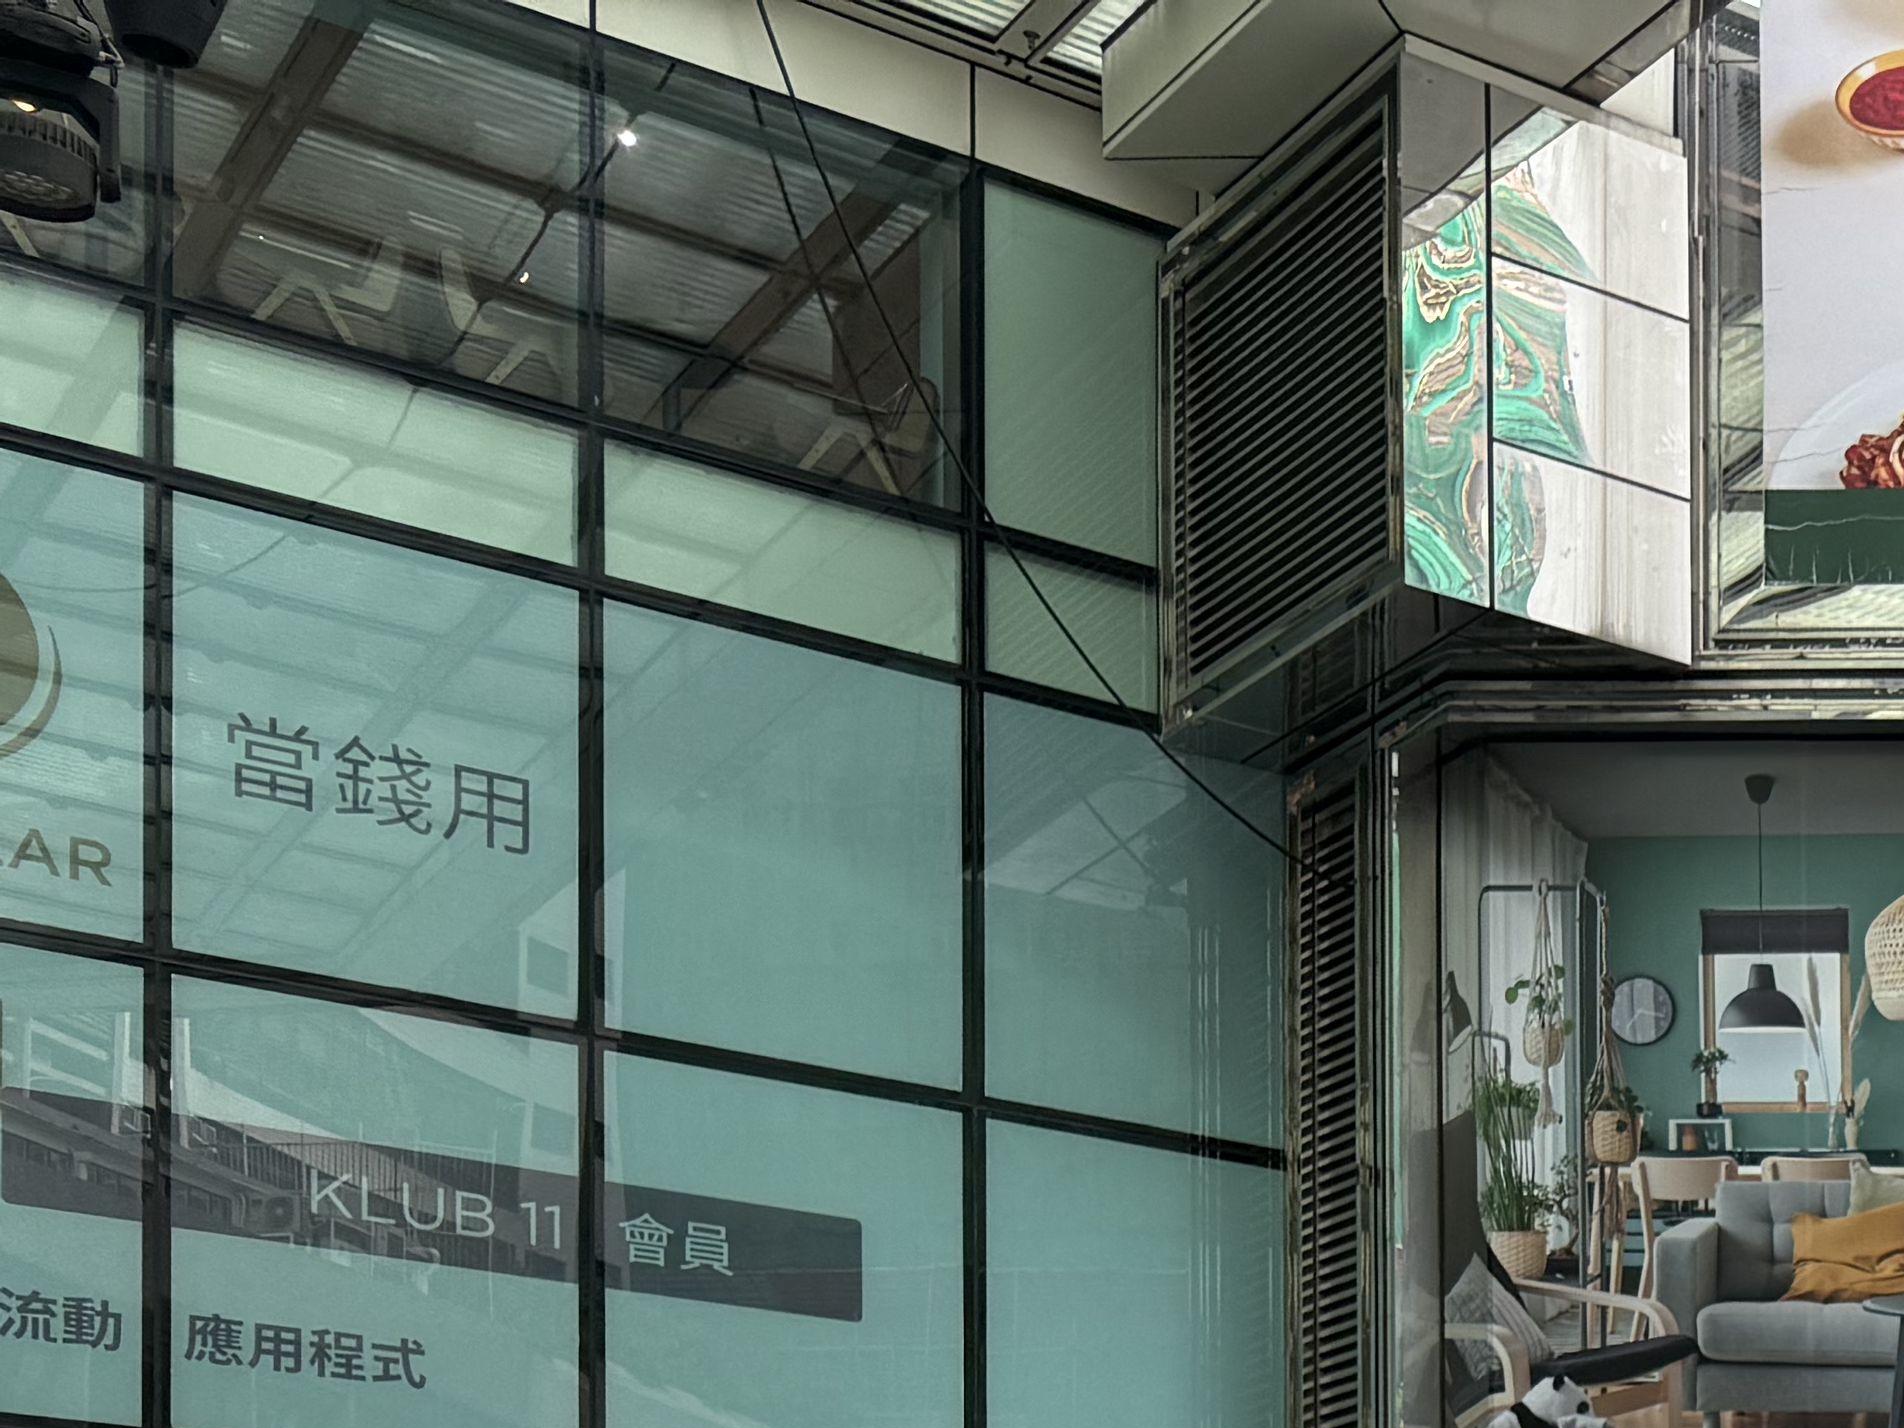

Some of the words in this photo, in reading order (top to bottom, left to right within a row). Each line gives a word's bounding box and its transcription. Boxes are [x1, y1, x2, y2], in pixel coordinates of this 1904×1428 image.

[226, 711, 530, 856] 當錢用
[0, 827, 113, 887] AR
[309, 1167, 495, 1239] KLUB
[519, 1200, 562, 1251] 11
[618, 1212, 736, 1277] 會員
[0, 1284, 124, 1355] 流動
[183, 1313, 428, 1391] 應用程式
